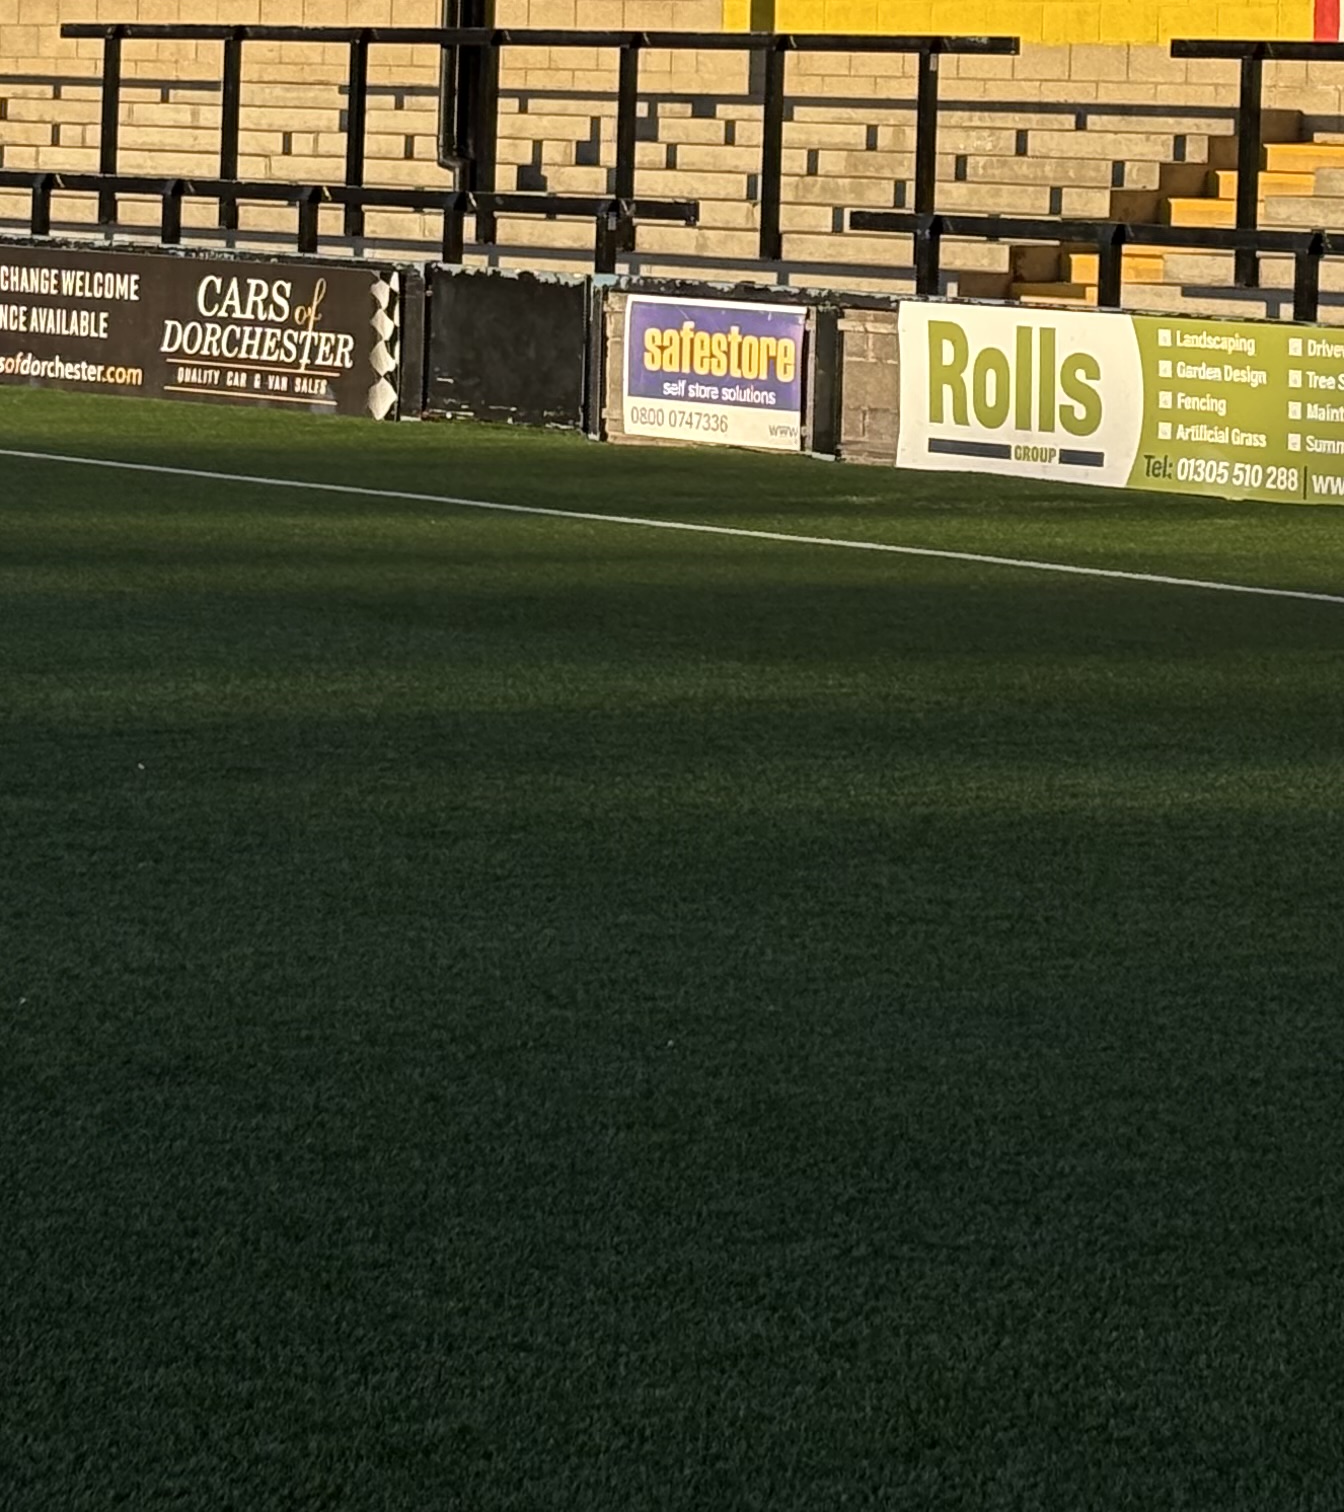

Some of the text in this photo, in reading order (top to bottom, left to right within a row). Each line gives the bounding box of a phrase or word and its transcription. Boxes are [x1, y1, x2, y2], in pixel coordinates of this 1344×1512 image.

[60, 269, 140, 301] WELCOME
[29, 307, 109, 339] AVAILABLE
[197, 275, 327, 343] CARS of
[160, 319, 355, 369] DORCHESTER
[643, 320, 796, 383] safestore
[1176, 330, 1256, 357] Landscaping
[177, 366, 221, 386] QUALITY
[226, 370, 247, 388] CAR
[267, 375, 288, 393] VAN
[294, 378, 328, 396] SALES
[928, 319, 1103, 437] Rolls
[1176, 361, 1267, 387] Garden Design
[1306, 371, 1336, 389] Tree
[662, 379, 777, 406] self store solutions
[1176, 393, 1227, 416] Fencing
[630, 406, 665, 427] 0800
[668, 408, 729, 433] 0747336
[1176, 423, 1267, 449] Artificial Grass
[1014, 444, 1057, 465] GROUP
[1143, 454, 1174, 480] Tel:
[1176, 456, 1230, 484] 01305
[1232, 461, 1263, 487] 510
[1265, 464, 1299, 492] 288
